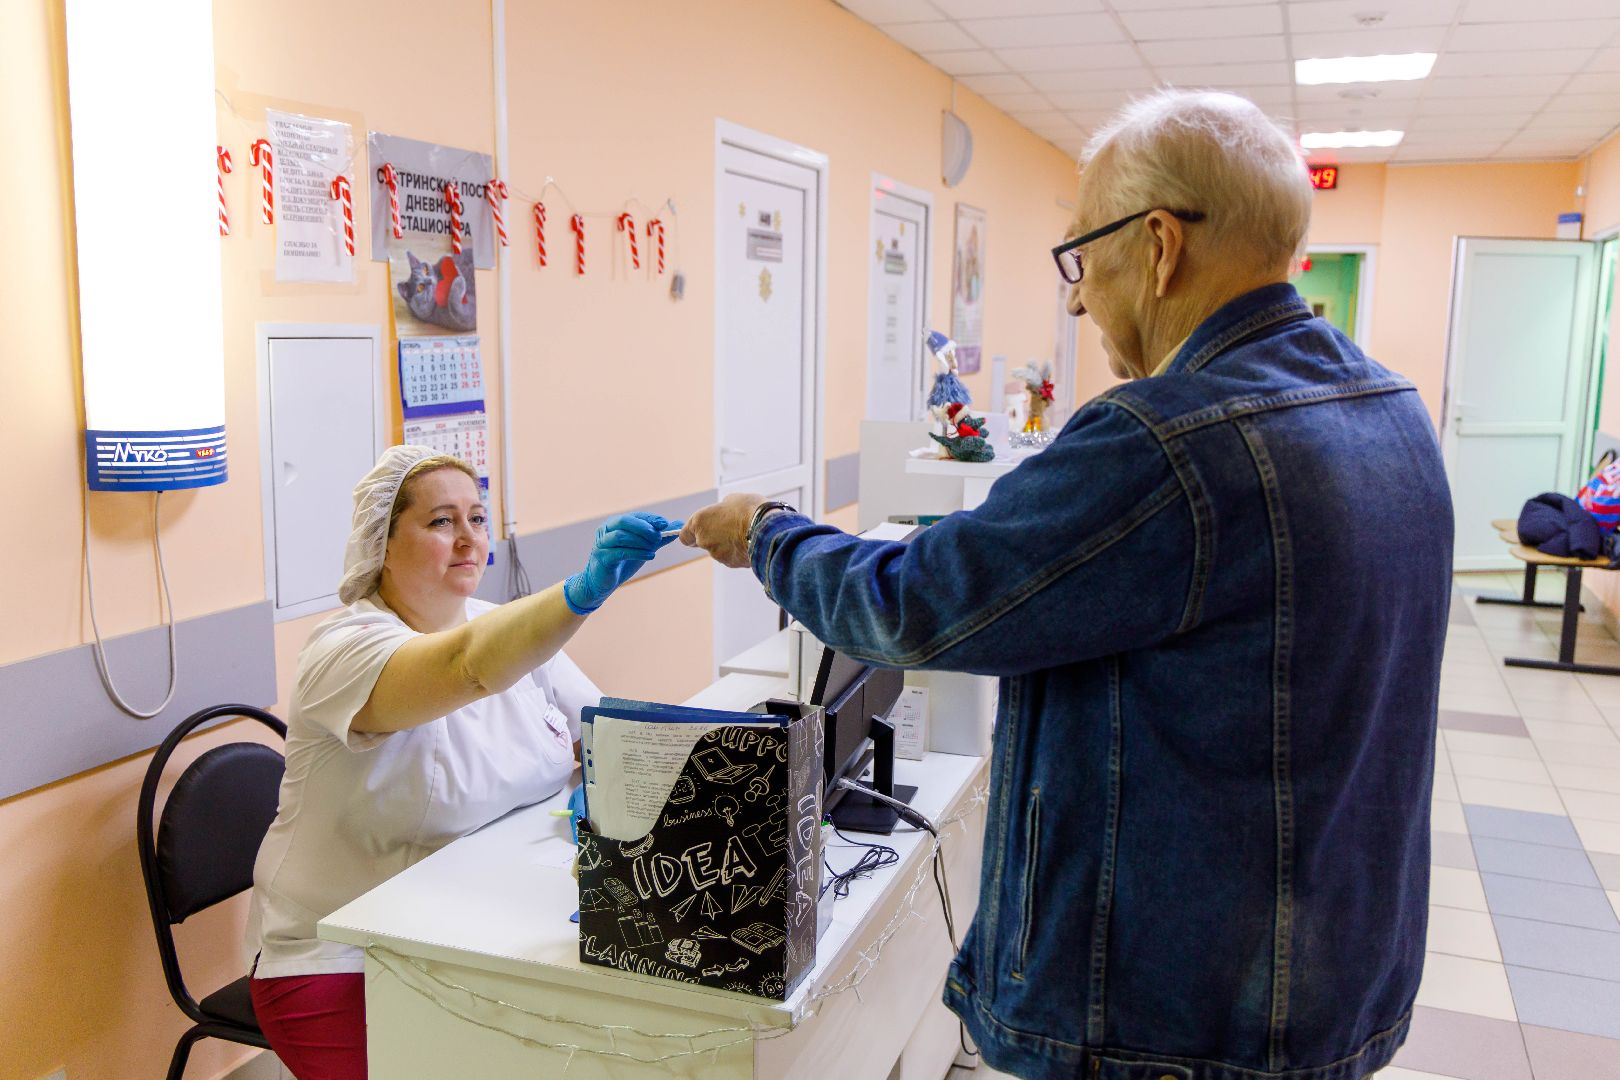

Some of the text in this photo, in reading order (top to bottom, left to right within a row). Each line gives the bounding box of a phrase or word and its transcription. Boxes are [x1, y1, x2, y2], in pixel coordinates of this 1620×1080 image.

[461, 181, 489, 199] ПОСТ
[405, 194, 464, 216] ДНЕВНОО
[400, 214, 471, 237] СТАЦИОНРА
[663, 808, 713, 828] business
[633, 836, 757, 899] IDEA
[796, 794, 816, 927] IDEA
